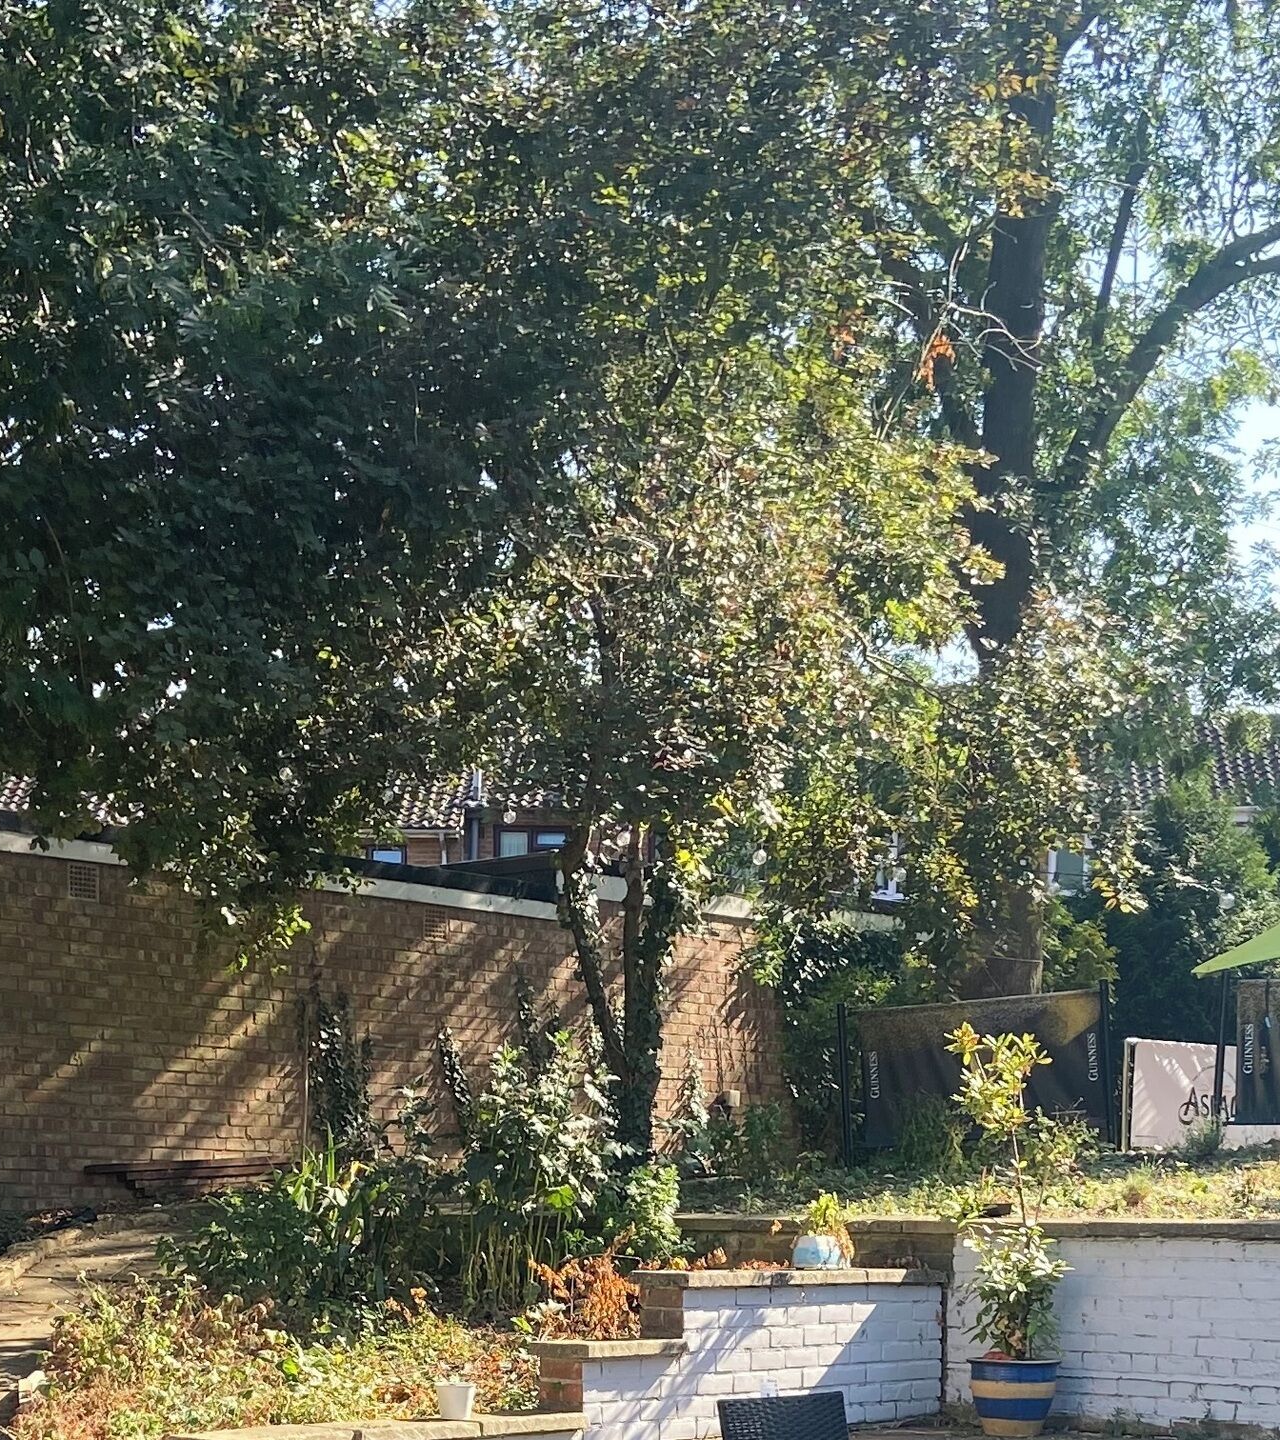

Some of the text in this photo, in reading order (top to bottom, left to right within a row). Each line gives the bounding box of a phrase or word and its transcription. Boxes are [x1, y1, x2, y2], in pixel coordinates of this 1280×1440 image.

[1088, 1032, 1099, 1082] GUINNESS
[1242, 1023, 1254, 1075] GUINNESS
[870, 1050, 880, 1099] GUINNESS
